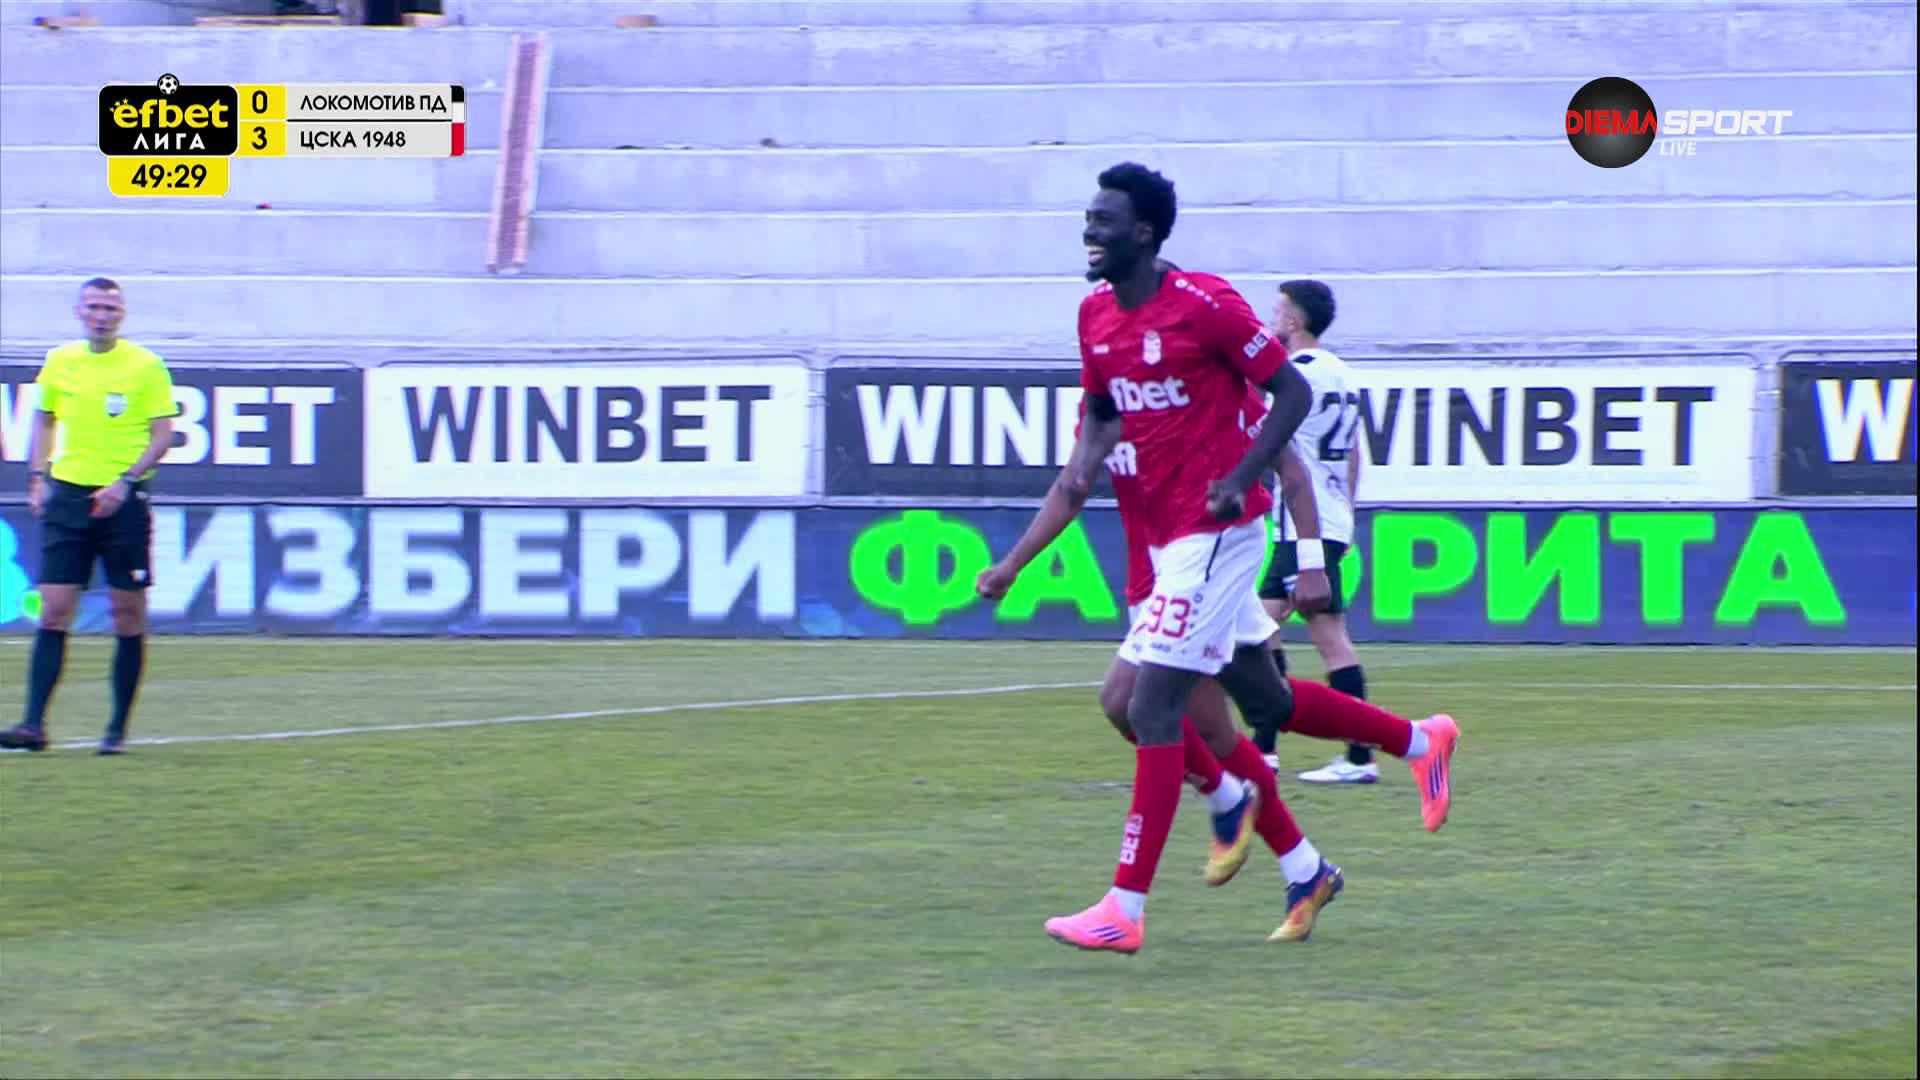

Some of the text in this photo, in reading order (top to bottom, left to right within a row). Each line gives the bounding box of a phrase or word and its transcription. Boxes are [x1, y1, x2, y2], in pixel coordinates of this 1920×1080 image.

[402, 386, 773, 463] WINBET
[1109, 375, 1190, 412] fbet
[150, 507, 797, 620] ИЗБЕРИ
[850, 510, 1847, 625] ФАРИТА
